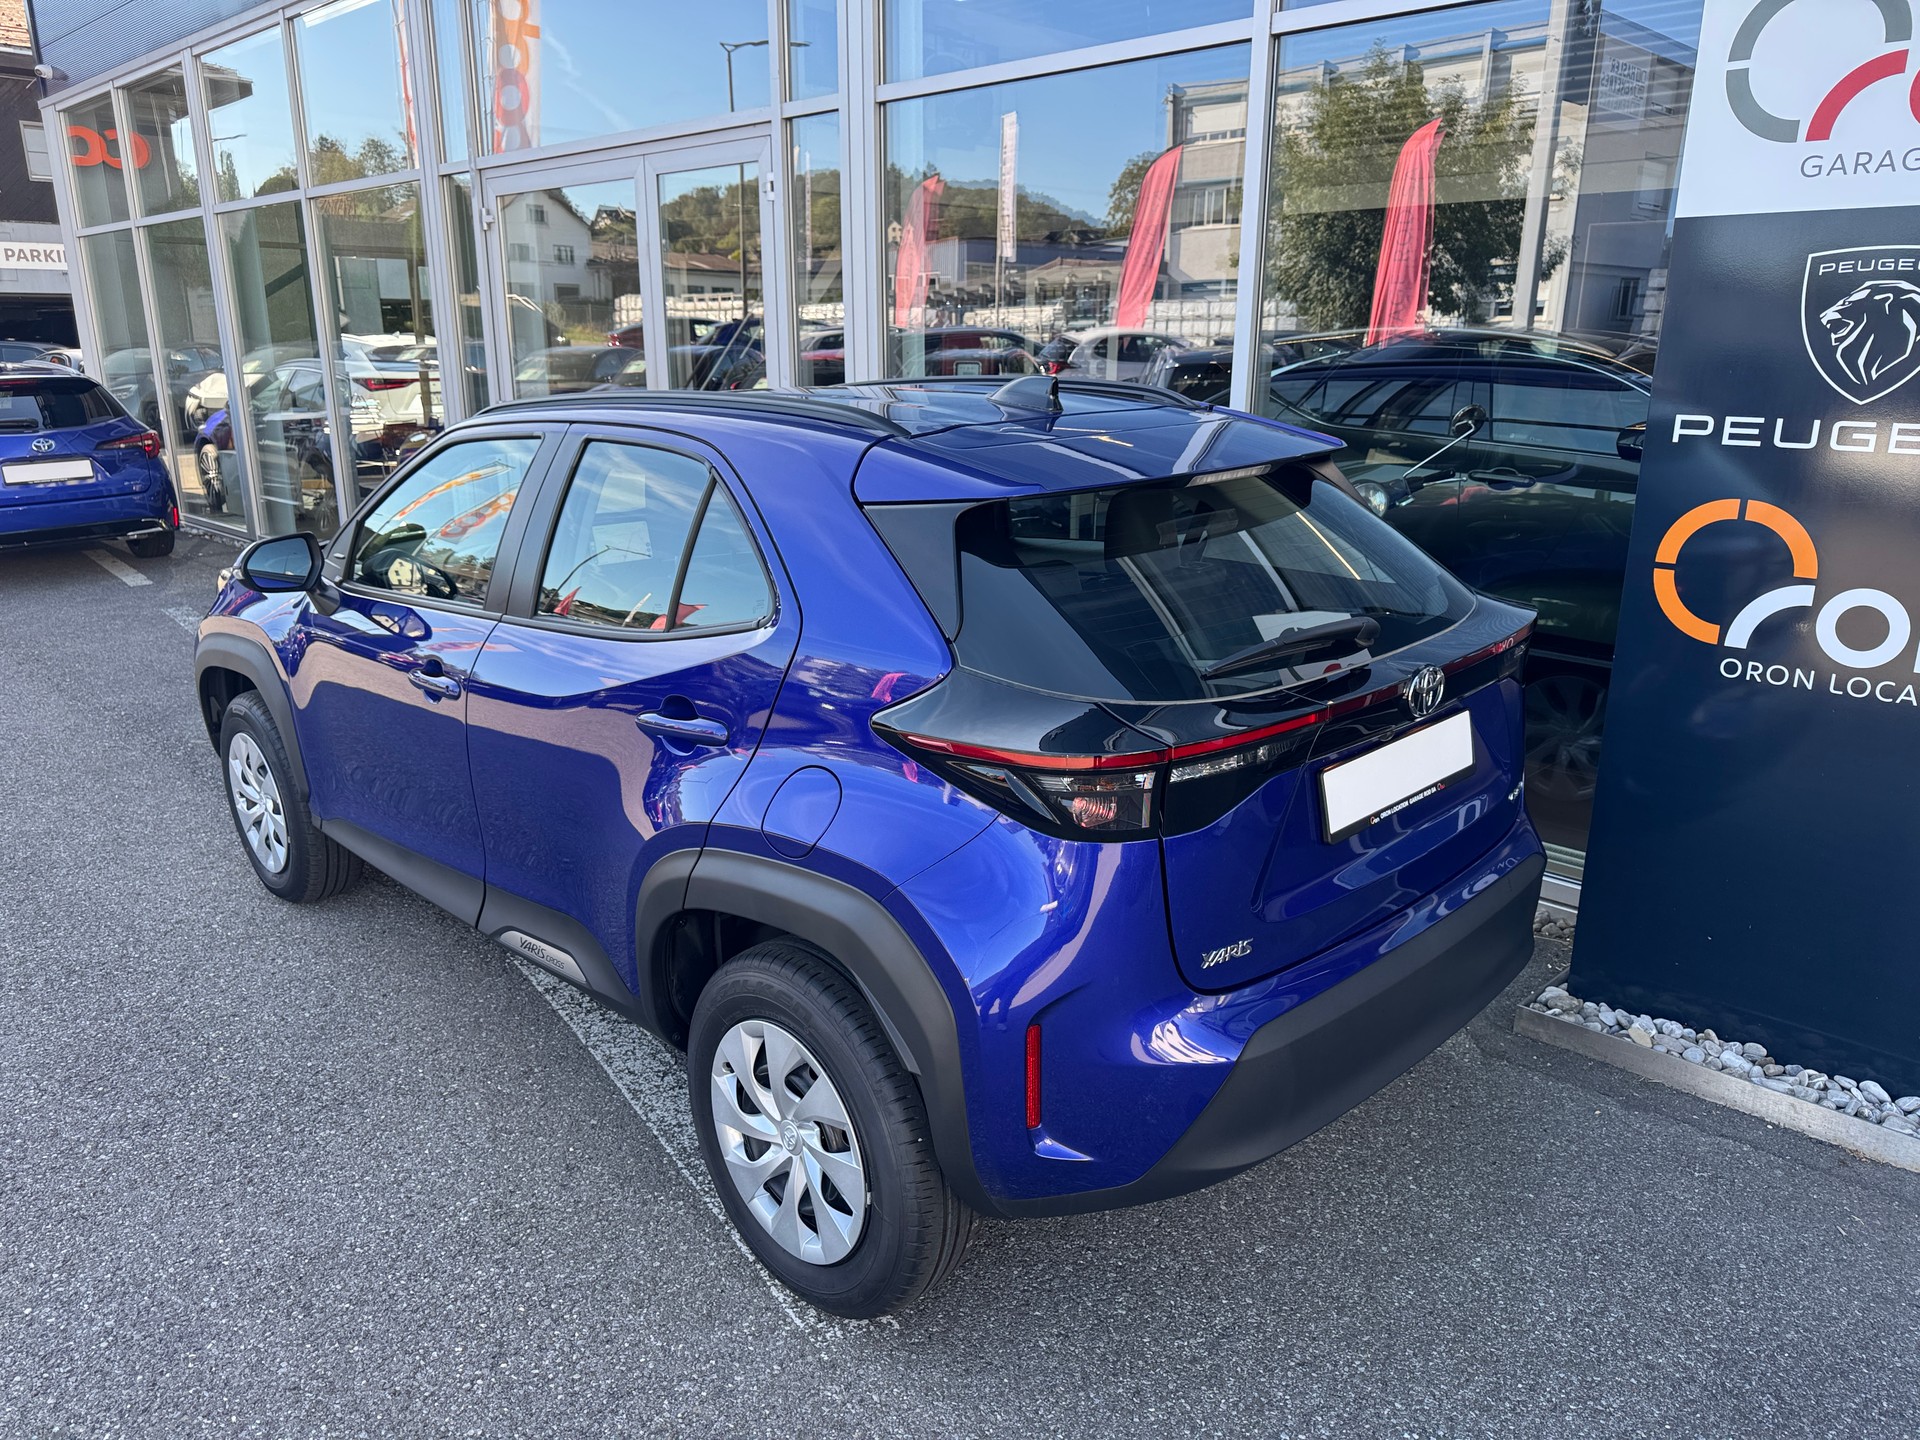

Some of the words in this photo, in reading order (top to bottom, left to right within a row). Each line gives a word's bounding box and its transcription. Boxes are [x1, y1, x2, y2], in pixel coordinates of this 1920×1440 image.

[4, 247, 67, 264] PARKI
[1818, 258, 1920, 276] PEUGE
[1720, 658, 1815, 691] ORON
[1829, 672, 1918, 707] LOCA
